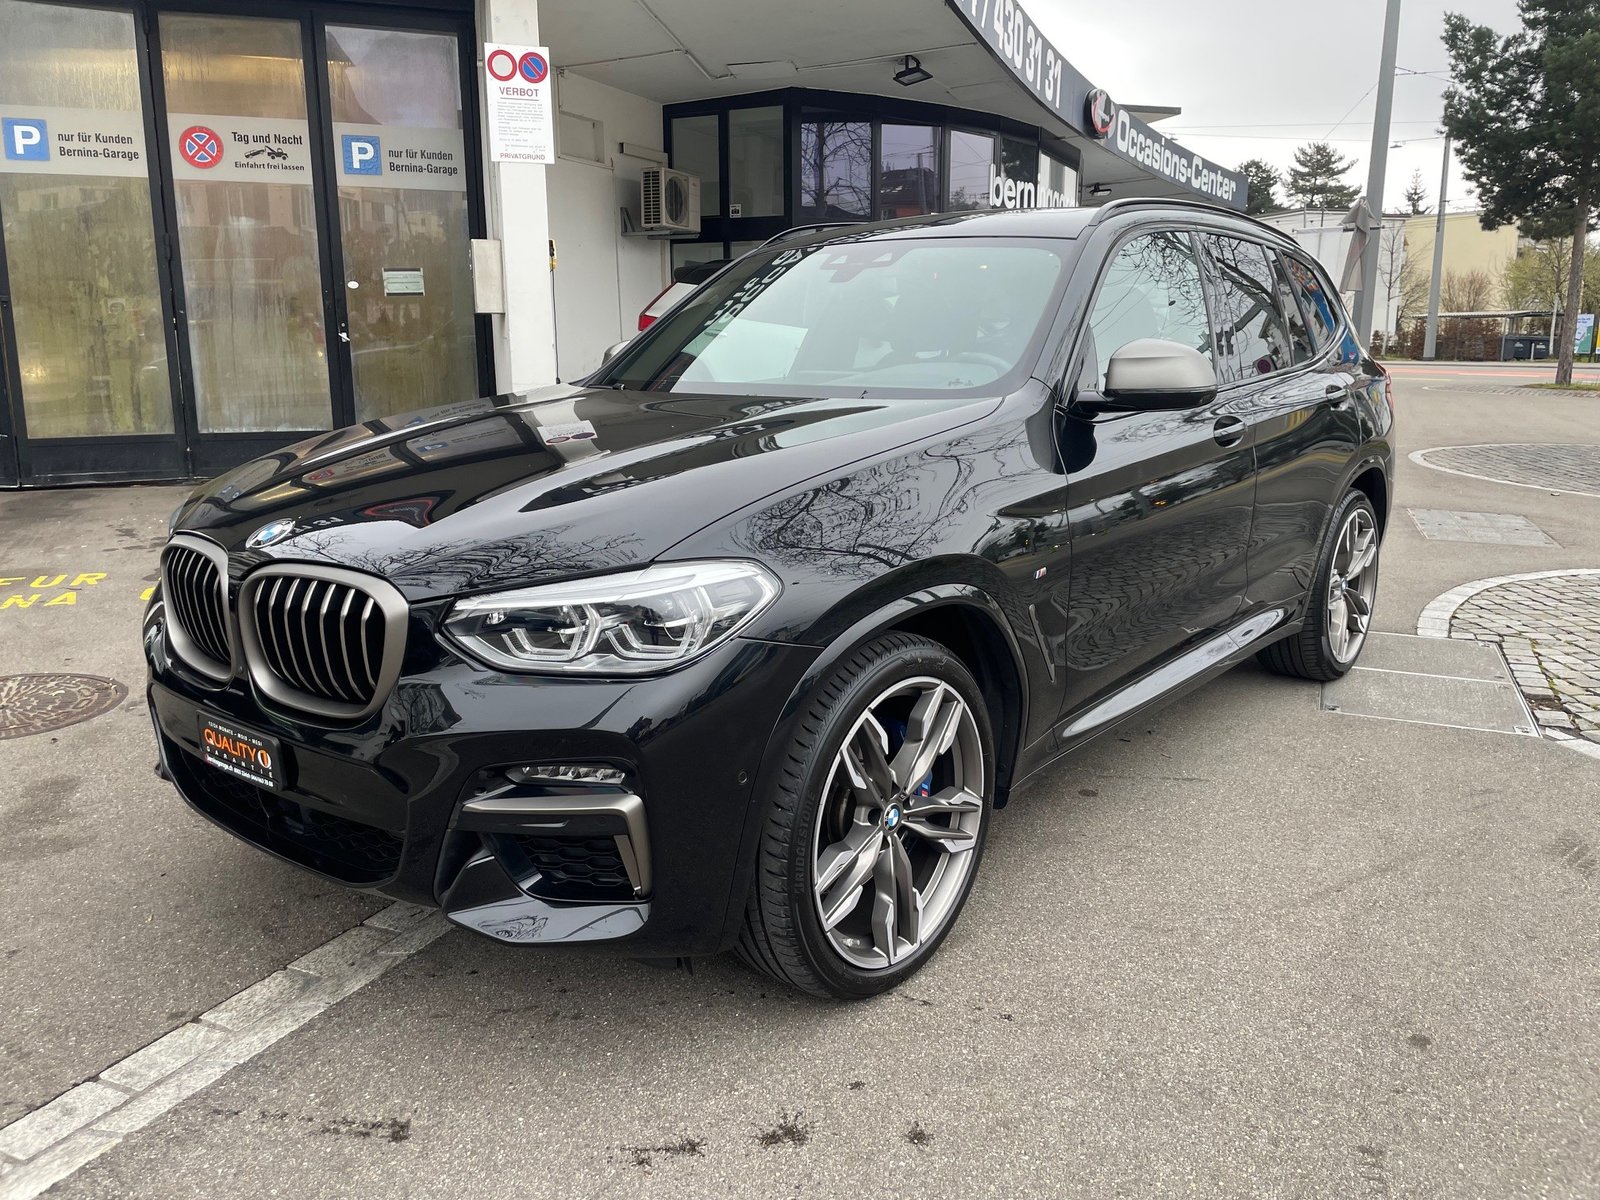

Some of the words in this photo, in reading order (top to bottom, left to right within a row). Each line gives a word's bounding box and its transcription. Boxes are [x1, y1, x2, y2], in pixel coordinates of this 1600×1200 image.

[993, 0, 1024, 69] 430
[1025, 25, 1043, 91] 31
[1045, 48, 1062, 109] 31
[499, 86, 540, 98] VERBOT
[13, 125, 41, 155] P
[57, 133, 75, 142] nur
[77, 132, 92, 143] für
[94, 133, 133, 145] Kunden
[231, 131, 250, 145] Tag
[252, 134, 271, 144] und
[273, 134, 303, 146] Nacht
[59, 146, 140, 162] Bernina-Garage
[351, 141, 375, 169] P
[388, 149, 403, 158] nur
[404, 148, 418, 159] für
[420, 149, 453, 161] Kunden
[499, 152, 546, 161] PRIVATGRUND
[1116, 109, 1236, 201] Occasions-Center
[234, 161, 266, 169] Einfahrt
[266, 162, 280, 170] frei
[281, 163, 305, 171] lassen
[389, 161, 458, 176] Bernina-Garage
[204, 728, 256, 762] QUALITY
[206, 746, 272, 778] GARANTIE
